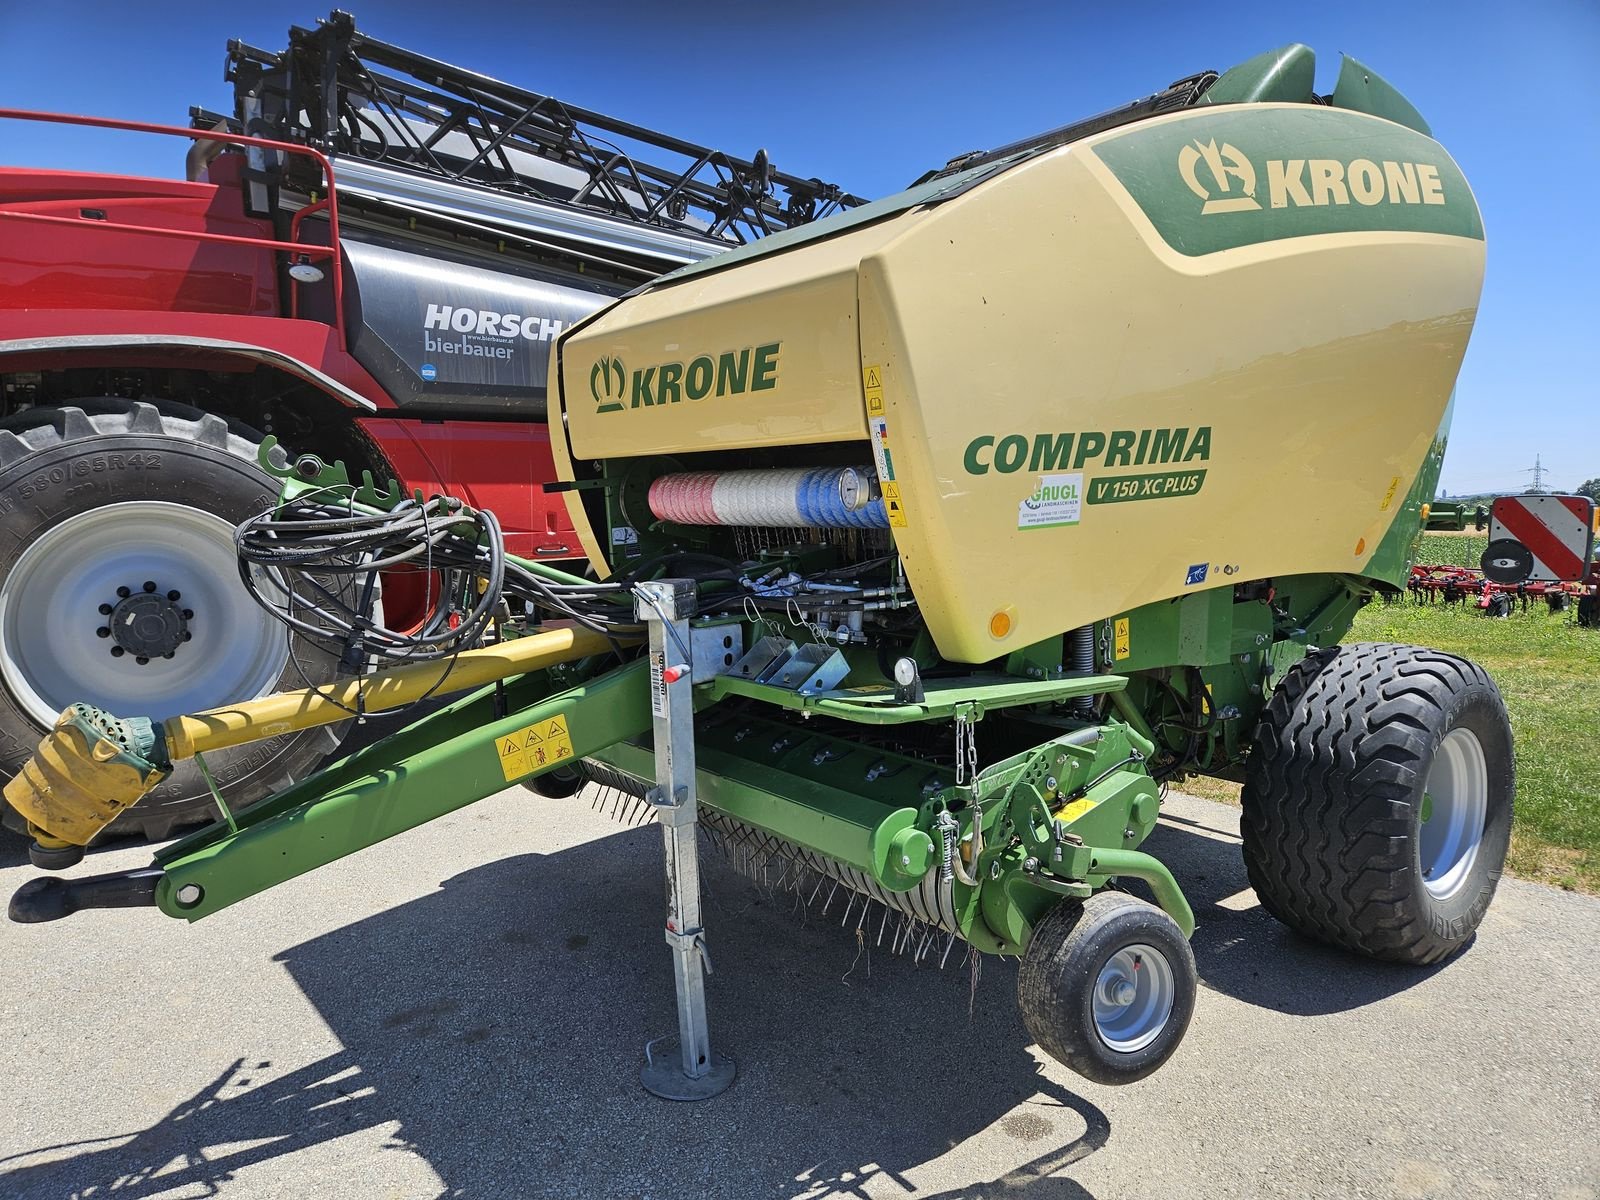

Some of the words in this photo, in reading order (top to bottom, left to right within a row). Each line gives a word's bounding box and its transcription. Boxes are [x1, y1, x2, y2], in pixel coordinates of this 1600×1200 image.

[1266, 158, 1446, 210] KRONE
[424, 303, 562, 342] HORSCH
[424, 330, 514, 359] bierbauer
[630, 341, 784, 409] KRONE
[963, 426, 1212, 476] COMPRIMA
[18, 453, 162, 499] 580/85R42
[1097, 482, 1108, 500] V
[1112, 479, 1138, 498] 150
[1141, 476, 1163, 495] XC
[1163, 474, 1199, 493] PLUS
[211, 732, 292, 784] RIFLEX
